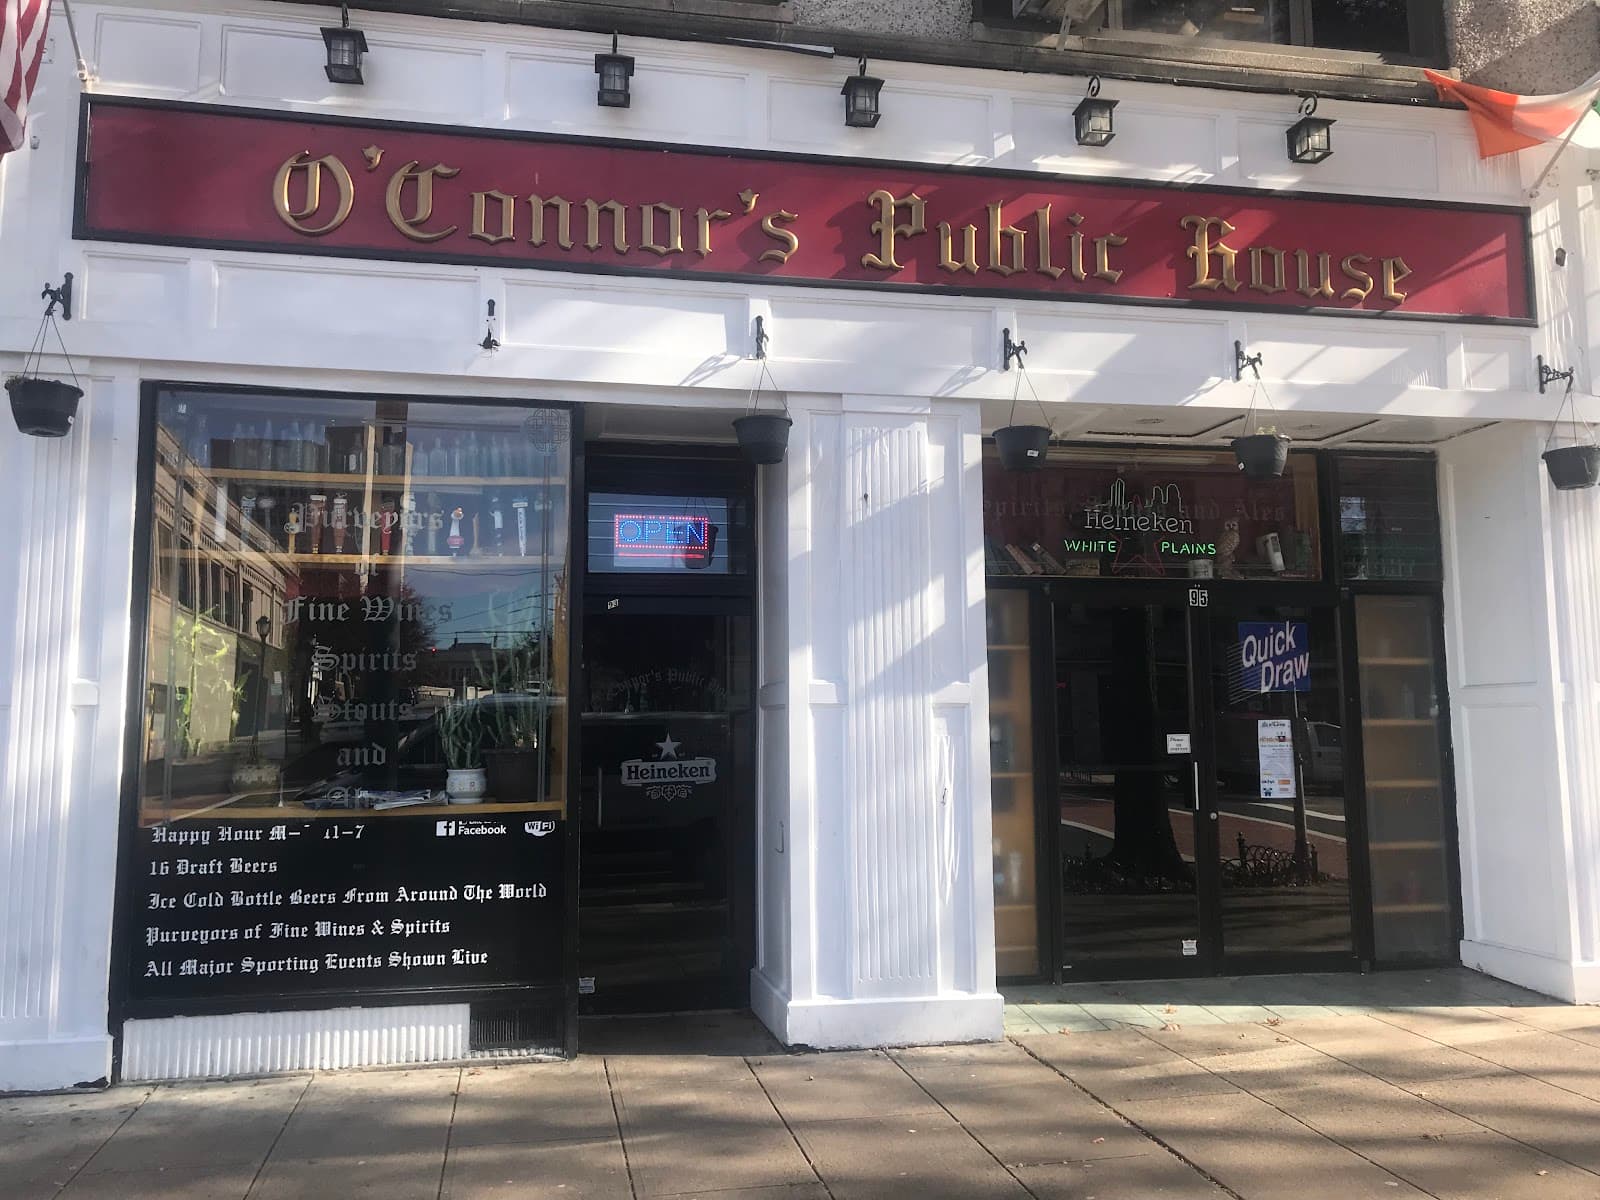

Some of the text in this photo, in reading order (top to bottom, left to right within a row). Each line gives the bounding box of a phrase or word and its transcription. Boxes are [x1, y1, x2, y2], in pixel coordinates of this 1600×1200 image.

[273, 145, 1412, 304] O'Connor's Public House
[619, 520, 705, 545] OPEN
[1083, 507, 1194, 535] Heineken
[1064, 539, 1217, 555] WHITE PLAINS
[284, 595, 454, 624] Fine Wines
[1190, 589, 1209, 607] 95
[1242, 620, 1297, 668] Quick
[311, 645, 418, 673] Spirits
[1260, 652, 1310, 694] Draw
[311, 695, 415, 723] Stouts
[337, 741, 388, 766] and
[626, 764, 711, 780] Heineken
[151, 826, 211, 846] Happy
[217, 825, 263, 842] Hour
[458, 824, 507, 836] Facebook
[149, 857, 278, 876] 16 Draft Beers
[147, 882, 548, 910] Ice Cold Bottle Beers From Around The World
[145, 917, 451, 947] Purveyors of Fine Wines & Spirits
[143, 947, 489, 978] All Major Sporting Events Shown Live
